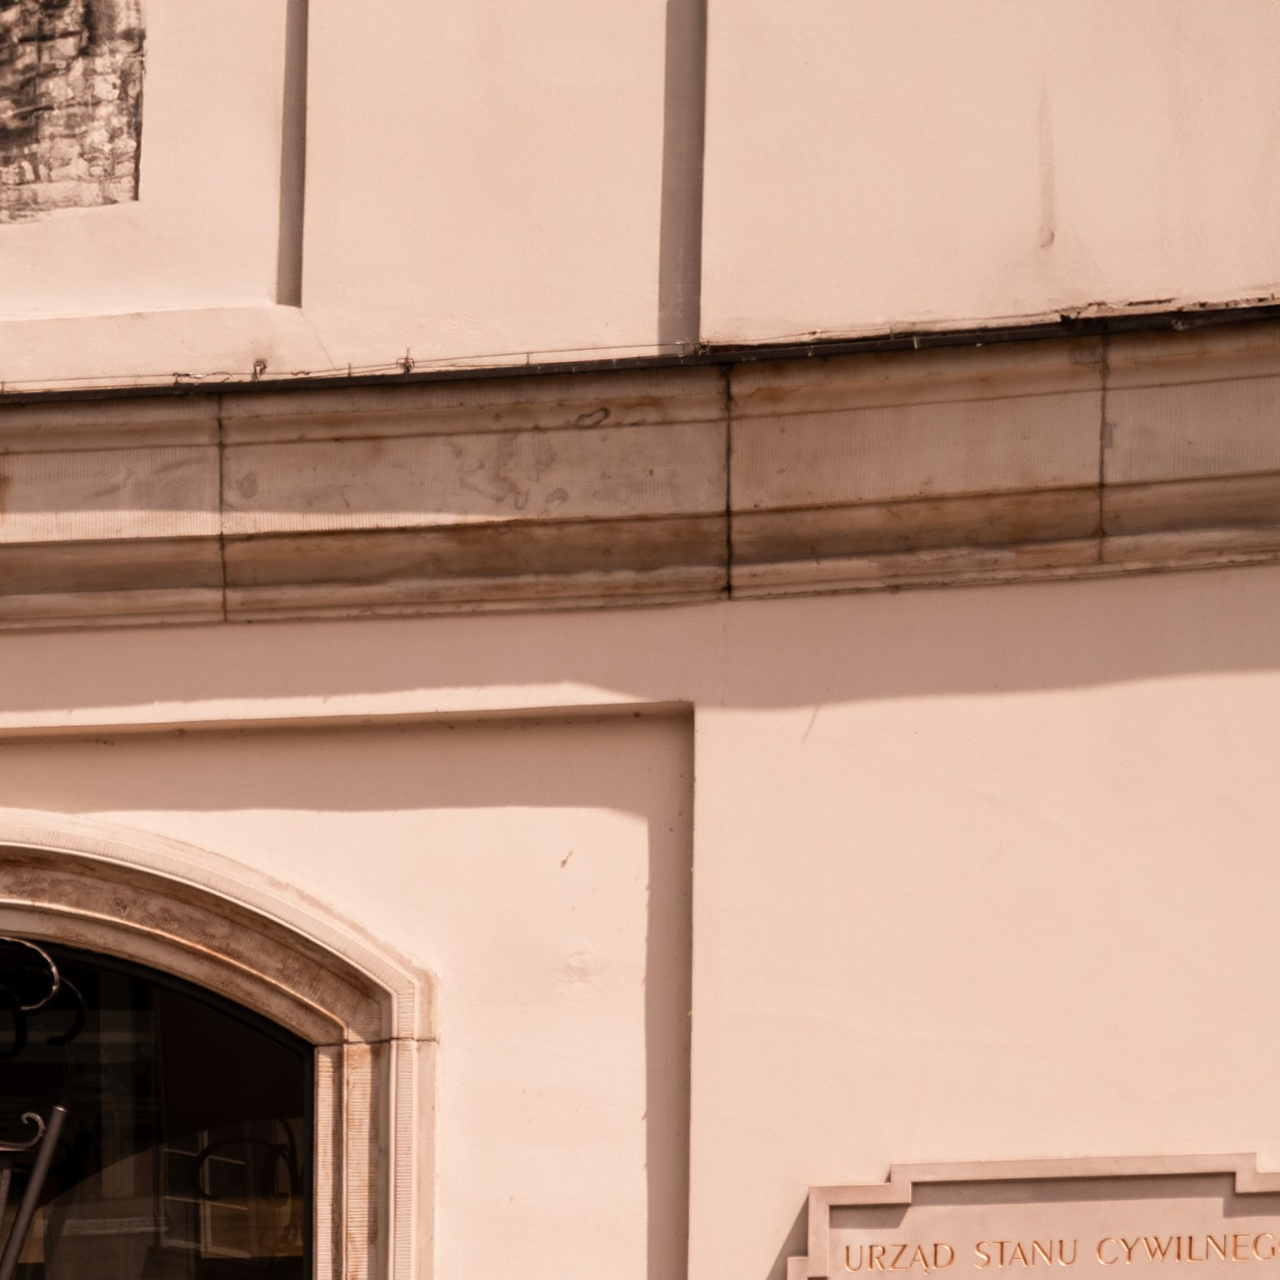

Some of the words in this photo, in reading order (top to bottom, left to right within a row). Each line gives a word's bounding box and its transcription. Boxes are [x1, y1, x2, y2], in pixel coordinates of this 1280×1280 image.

[844, 1243, 957, 1276] URZĄD
[972, 1239, 1078, 1270] STANU
[1095, 1232, 1280, 1268] CYWILNEG
